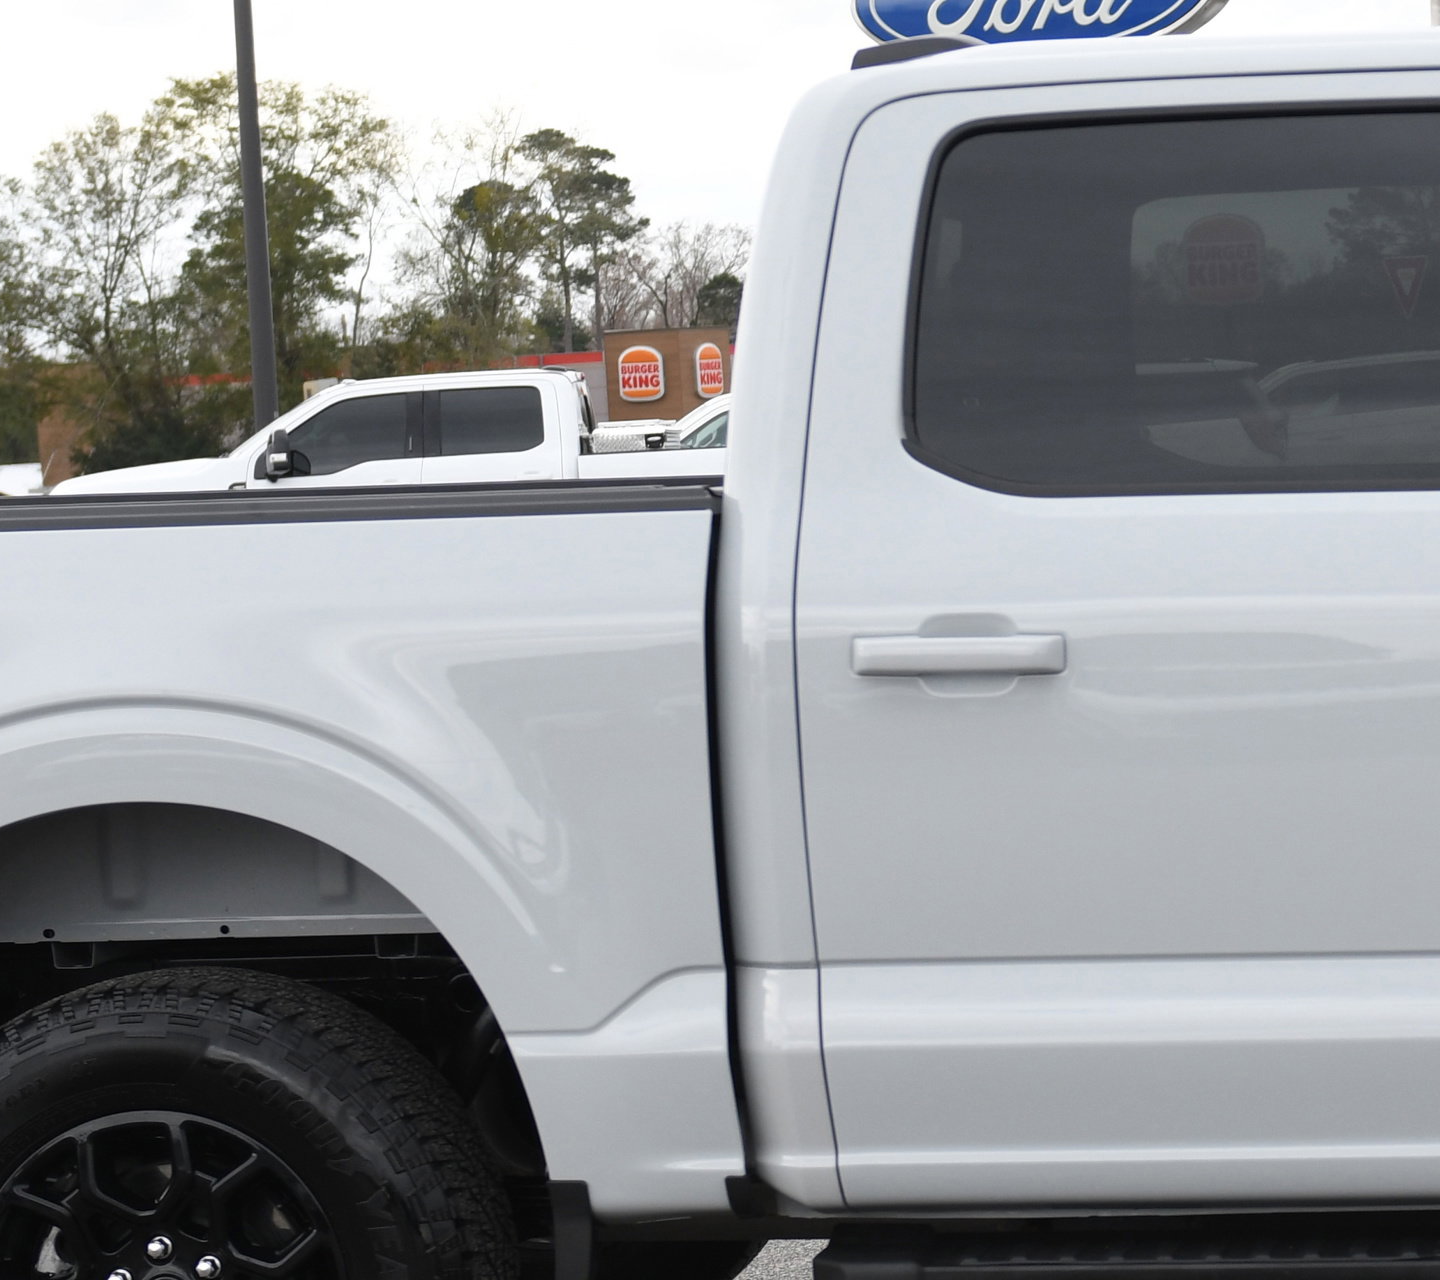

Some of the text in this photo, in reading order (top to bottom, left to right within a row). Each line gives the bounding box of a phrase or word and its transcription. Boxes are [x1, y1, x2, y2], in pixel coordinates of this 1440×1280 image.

[620, 364, 659, 375] BURGER
[621, 375, 661, 389] KING
[700, 371, 723, 385] KING
